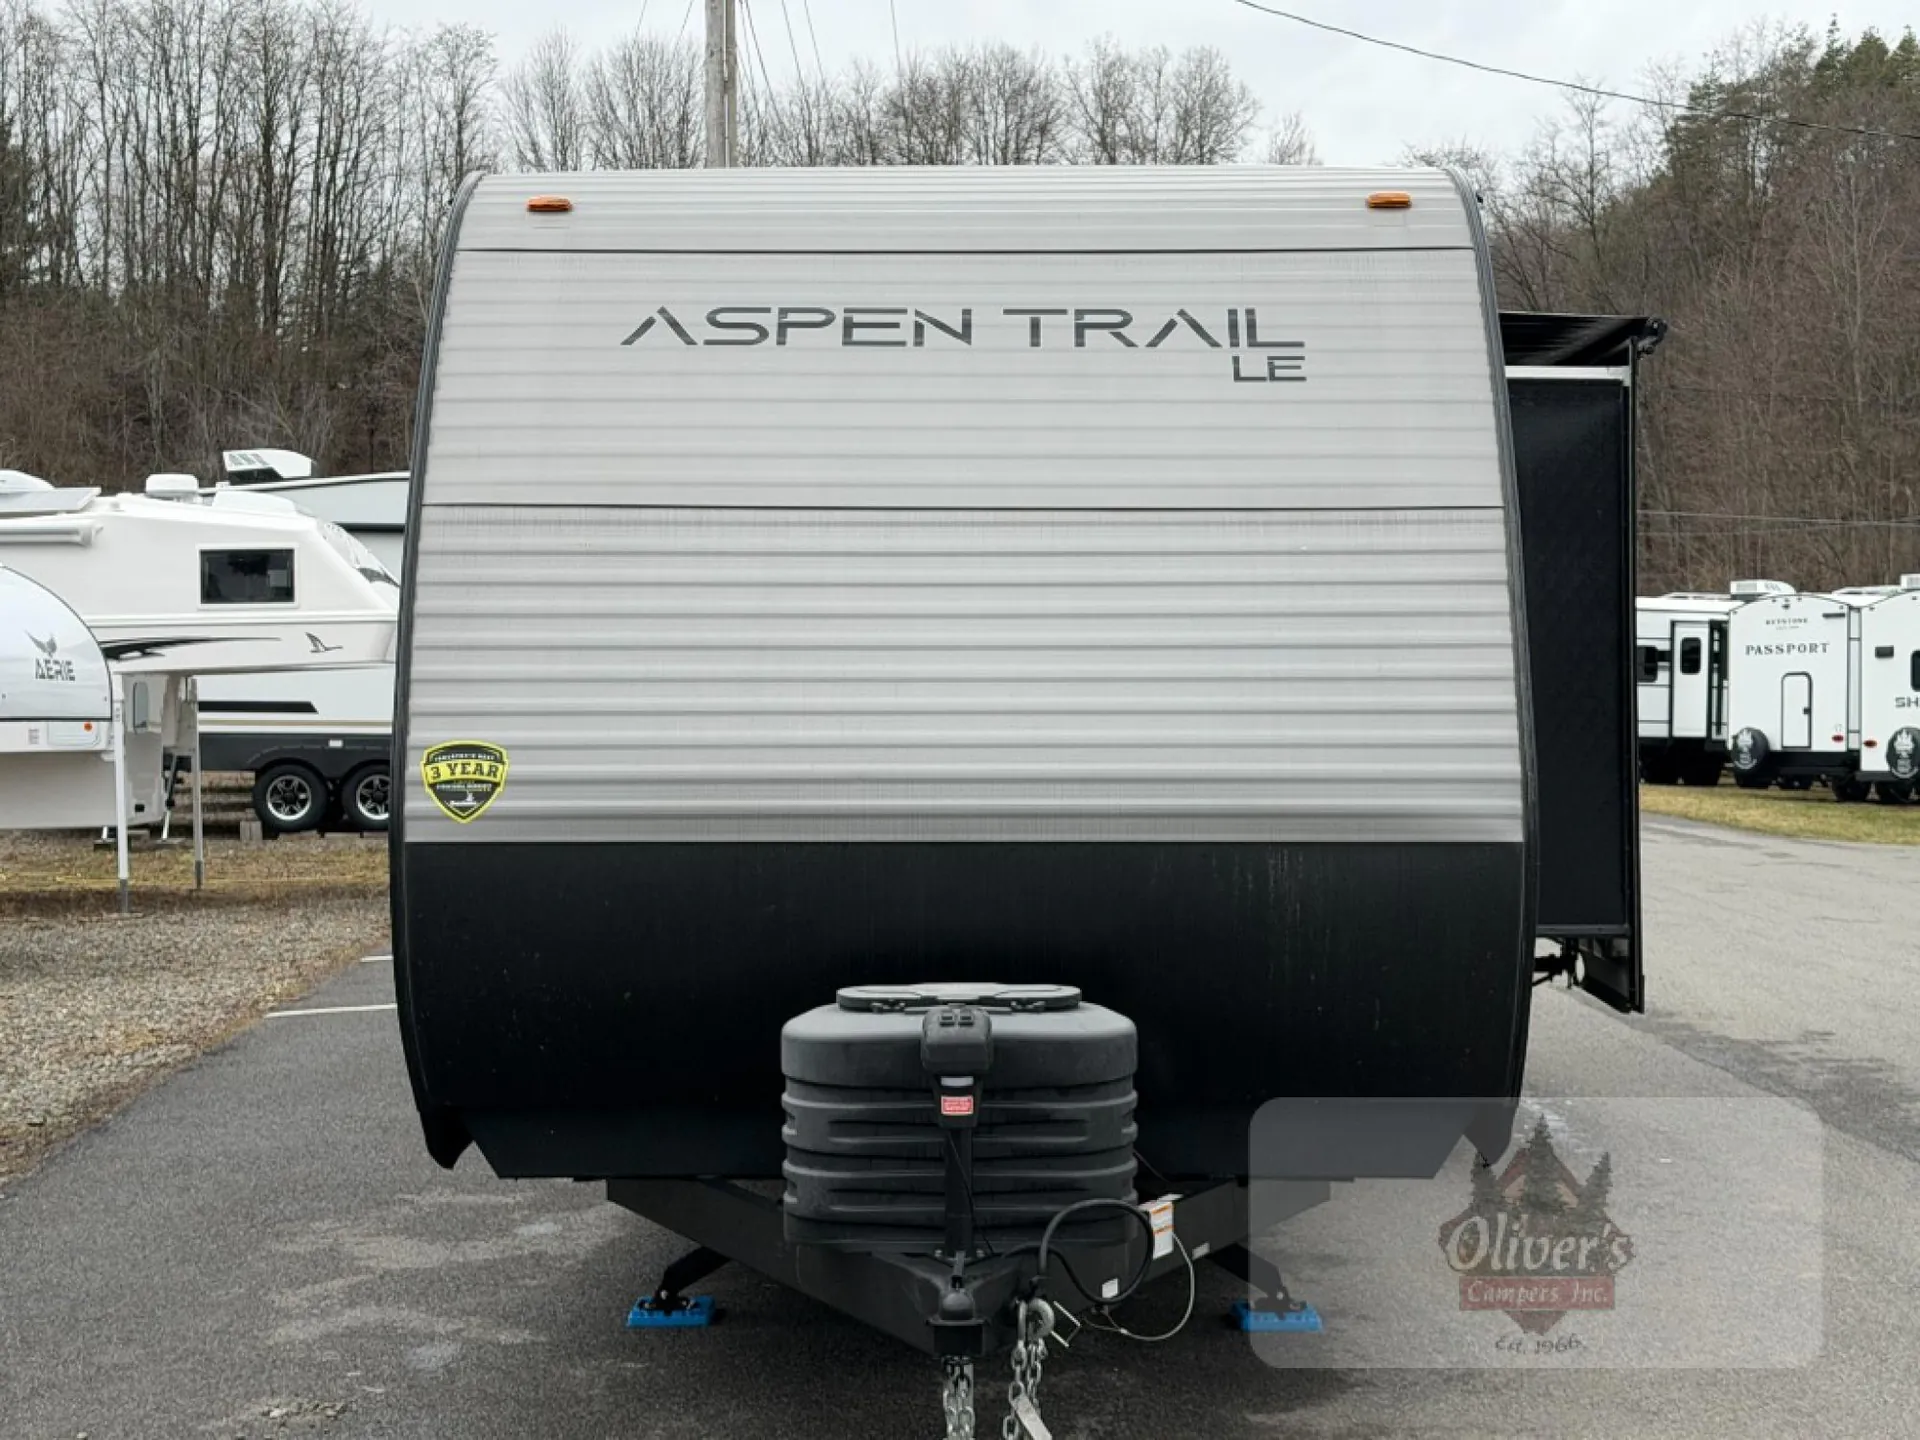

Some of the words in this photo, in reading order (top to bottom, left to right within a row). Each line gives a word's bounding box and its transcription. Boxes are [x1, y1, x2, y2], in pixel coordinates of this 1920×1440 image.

[620, 305, 973, 347] ASPEN
[1002, 308, 1306, 348] TRAIL
[1231, 355, 1308, 382] LE
[1745, 642, 1831, 656] PASSPORT
[430, 766, 441, 781] 3
[446, 761, 500, 779] YEAR
